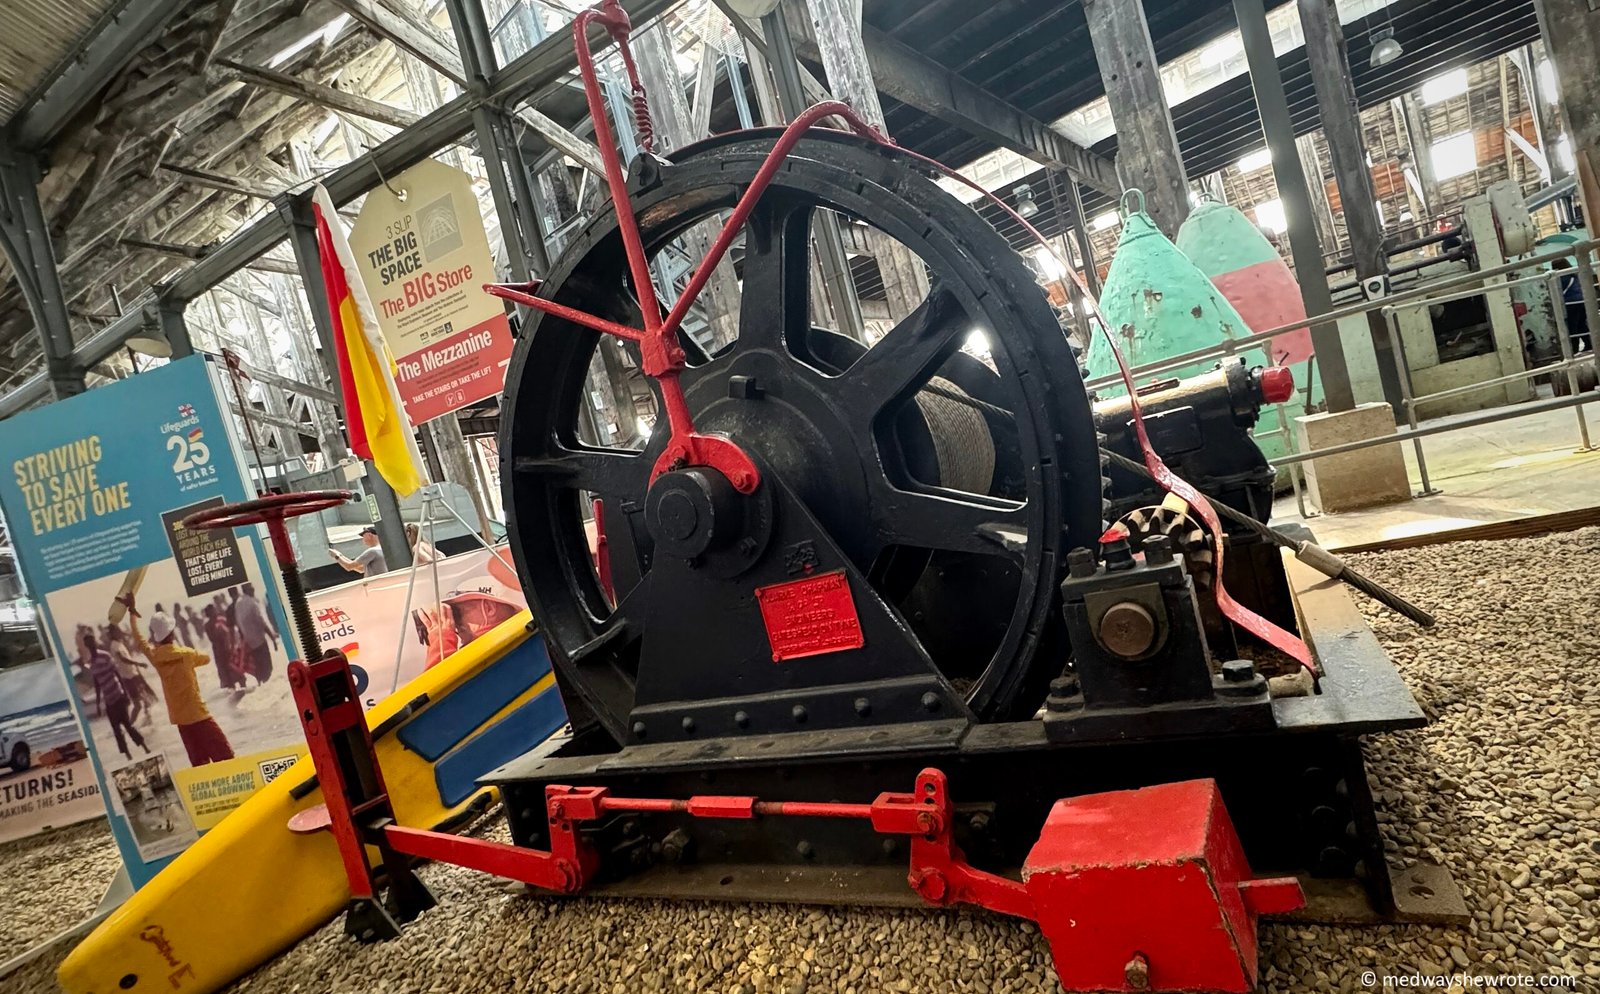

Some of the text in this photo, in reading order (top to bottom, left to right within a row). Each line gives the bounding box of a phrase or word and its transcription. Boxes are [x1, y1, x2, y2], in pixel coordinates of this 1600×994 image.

[385, 214, 412, 240] 3 SLIP
[368, 231, 418, 269] THE BIG
[380, 250, 423, 286] SPACE
[380, 297, 405, 319] The
[402, 271, 437, 308] BIG
[397, 361, 421, 383] The
[421, 330, 493, 373] Mezzanine
[412, 366, 492, 404] TAKE THE STAIRS OR TAKE THE LIFT
[160, 415, 200, 434] Lifeguards
[14, 435, 102, 486] STRIVING
[167, 428, 210, 473] 25
[22, 464, 99, 511] TO SAVE
[176, 465, 216, 485] YEARS
[31, 481, 131, 536] EVERY ONE
[184, 546, 232, 568] THAT'S ONE LIFE
[204, 559, 223, 573] EVERY
[190, 566, 233, 587] OTHER MINUTE
[0, 768, 73, 806] TURNS!
[188, 771, 254, 794] LEARN MORE ABOUT
[190, 782, 256, 802] GLOBAL DROWNING
[36, 795, 54, 812] THE
